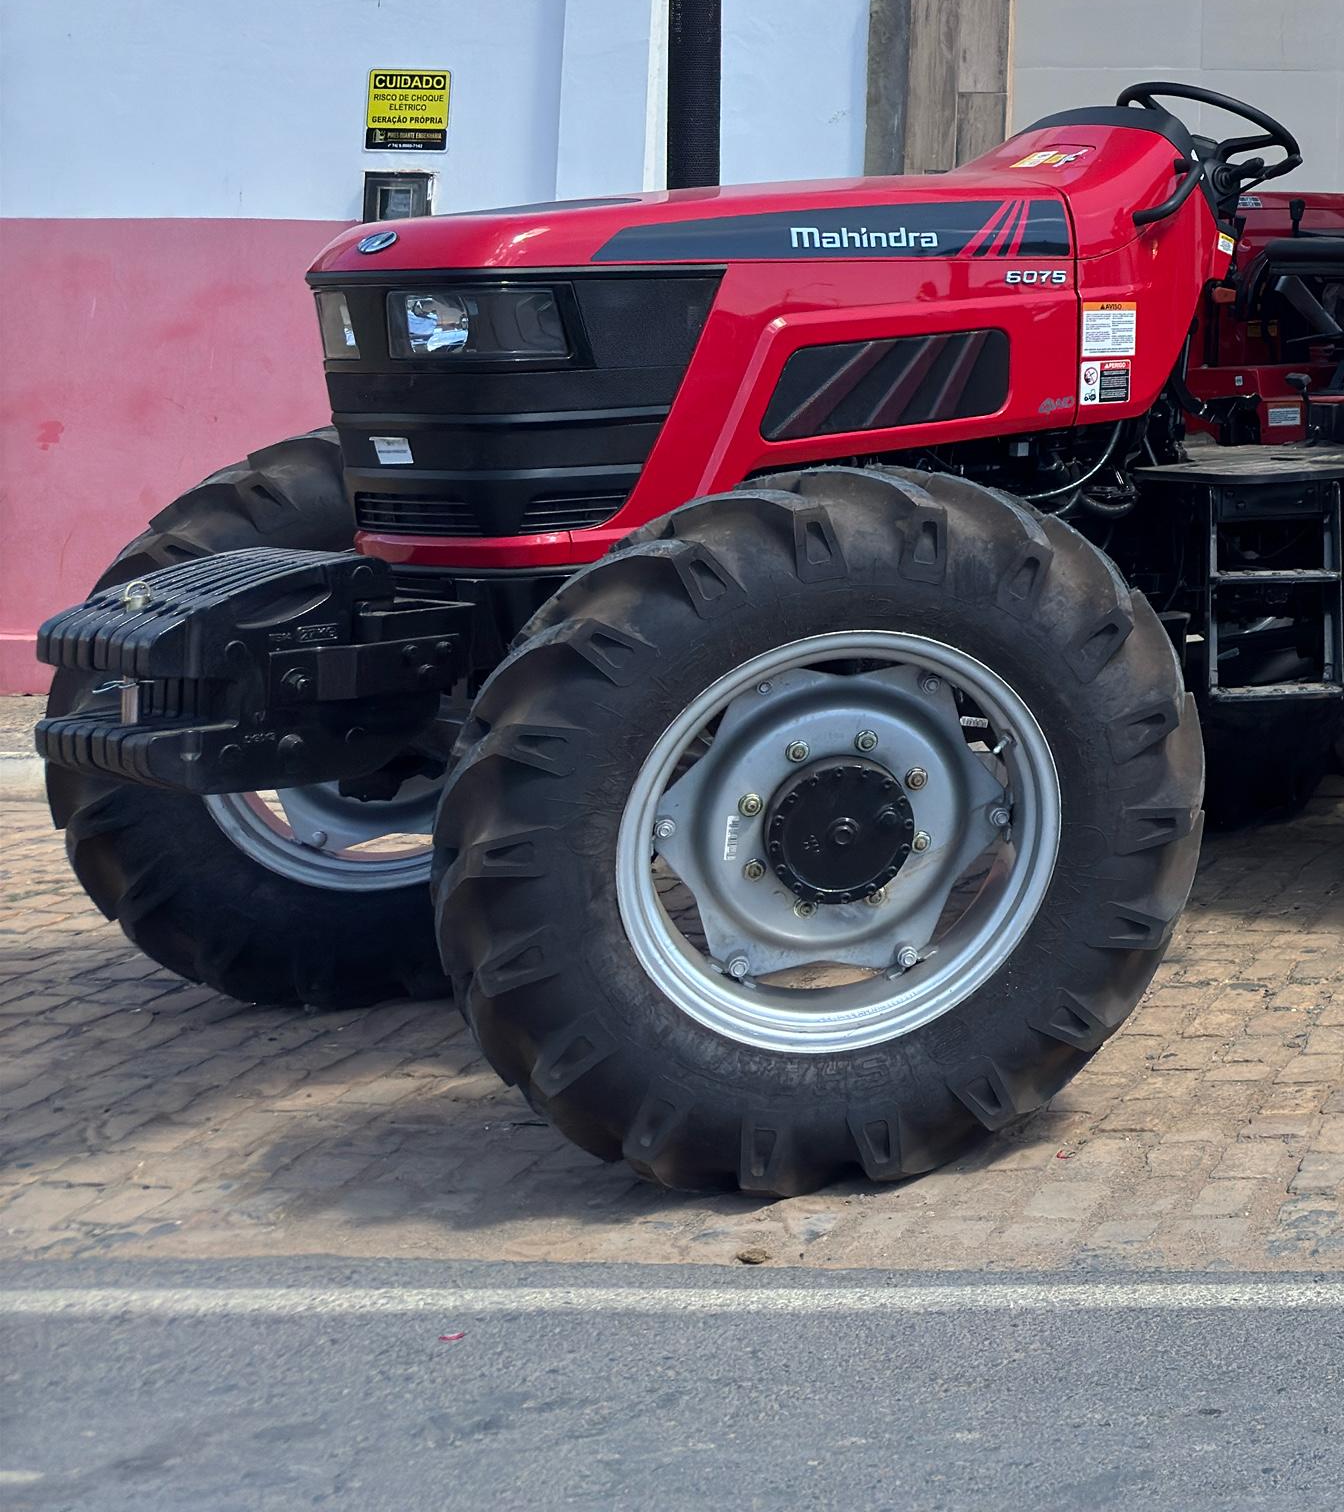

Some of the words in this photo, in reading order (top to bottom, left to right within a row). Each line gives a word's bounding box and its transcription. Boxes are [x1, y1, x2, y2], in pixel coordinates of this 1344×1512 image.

[375, 75, 445, 88] CUIDADO
[373, 94, 397, 102] RISCO
[398, 94, 410, 102] DE
[411, 94, 445, 102] CHOQUE
[388, 102, 427, 111] ELÉTRICO
[371, 114, 408, 125] GERAÇÃO
[409, 115, 443, 125] PRÓPRIA
[790, 226, 938, 249] Mahindra
[1005, 270, 1067, 284] 6075
